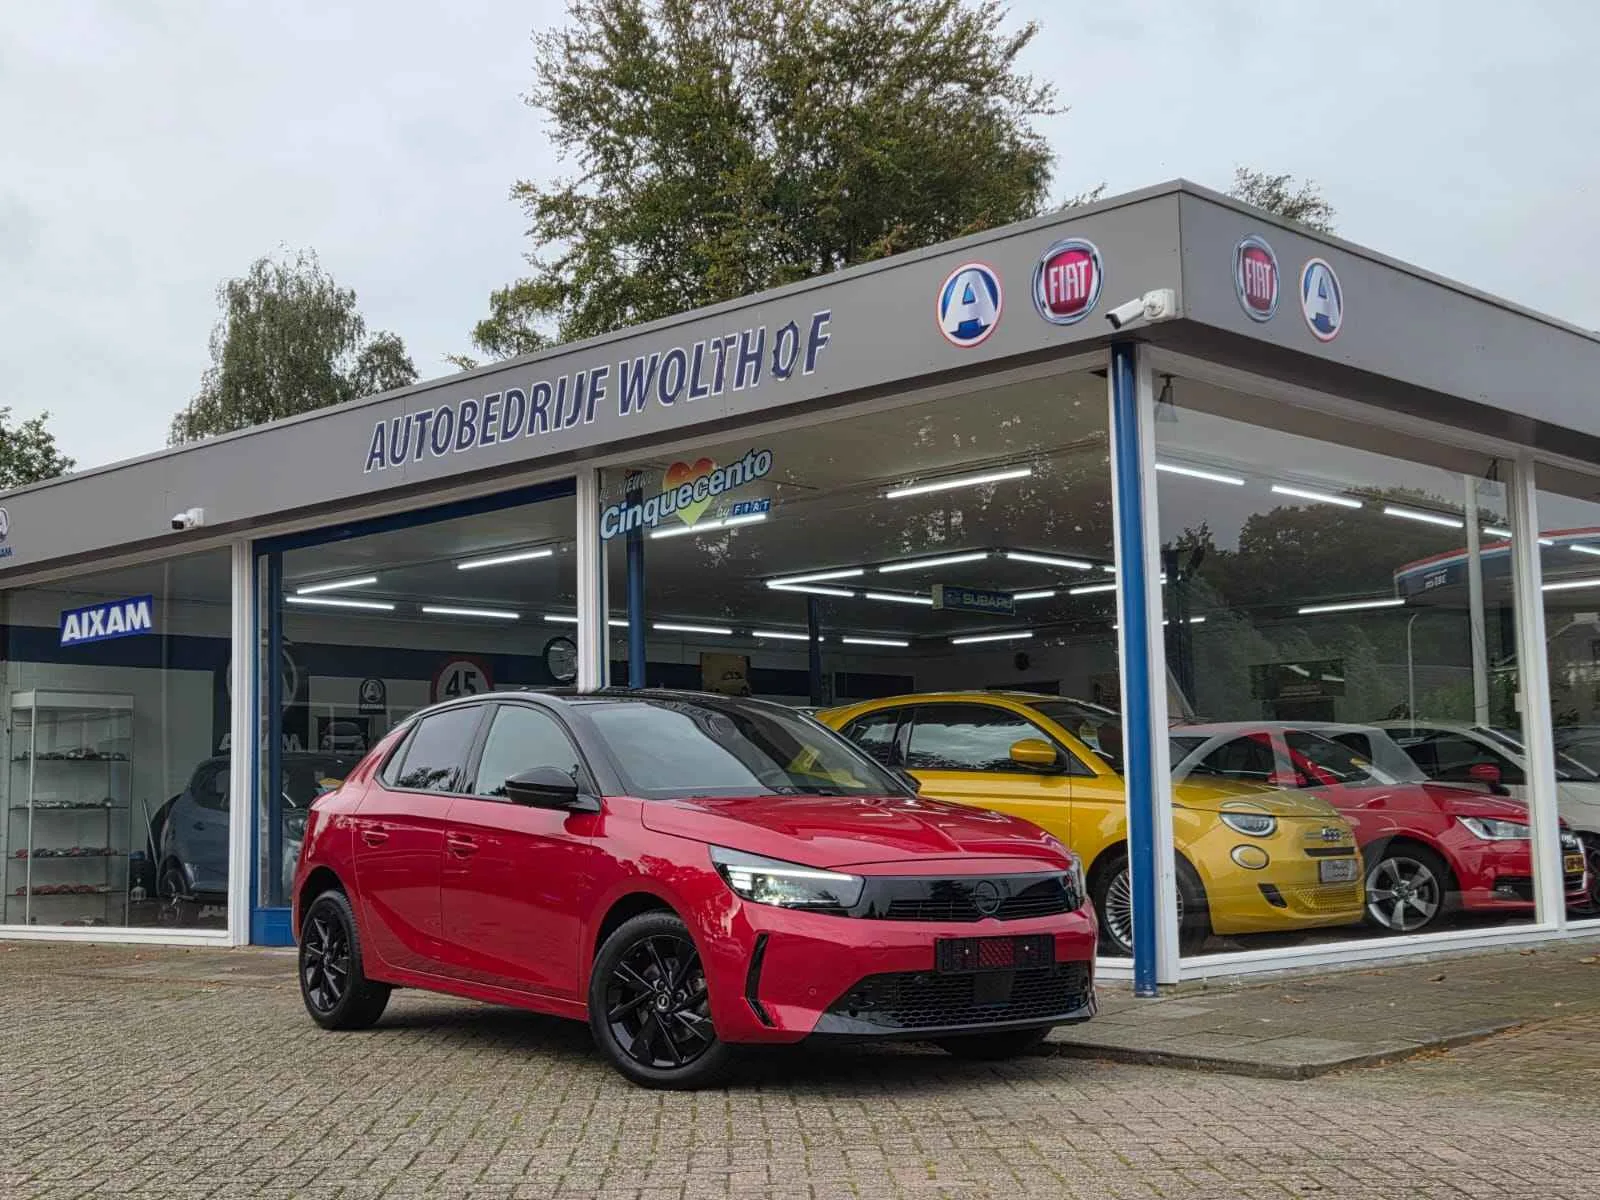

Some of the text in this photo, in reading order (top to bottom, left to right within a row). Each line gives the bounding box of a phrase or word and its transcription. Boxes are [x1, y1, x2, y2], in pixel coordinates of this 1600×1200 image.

[943, 269, 997, 333] A
[1050, 259, 1089, 305] FIAT
[1245, 257, 1271, 300] FIAT
[1306, 264, 1340, 328] A
[363, 310, 832, 473] AUTOBEDRIJF WOLTHOF
[600, 448, 772, 541] Cinquecento
[734, 499, 770, 515] FIAT
[61, 601, 152, 642] AIXAM
[446, 669, 477, 697] 45
